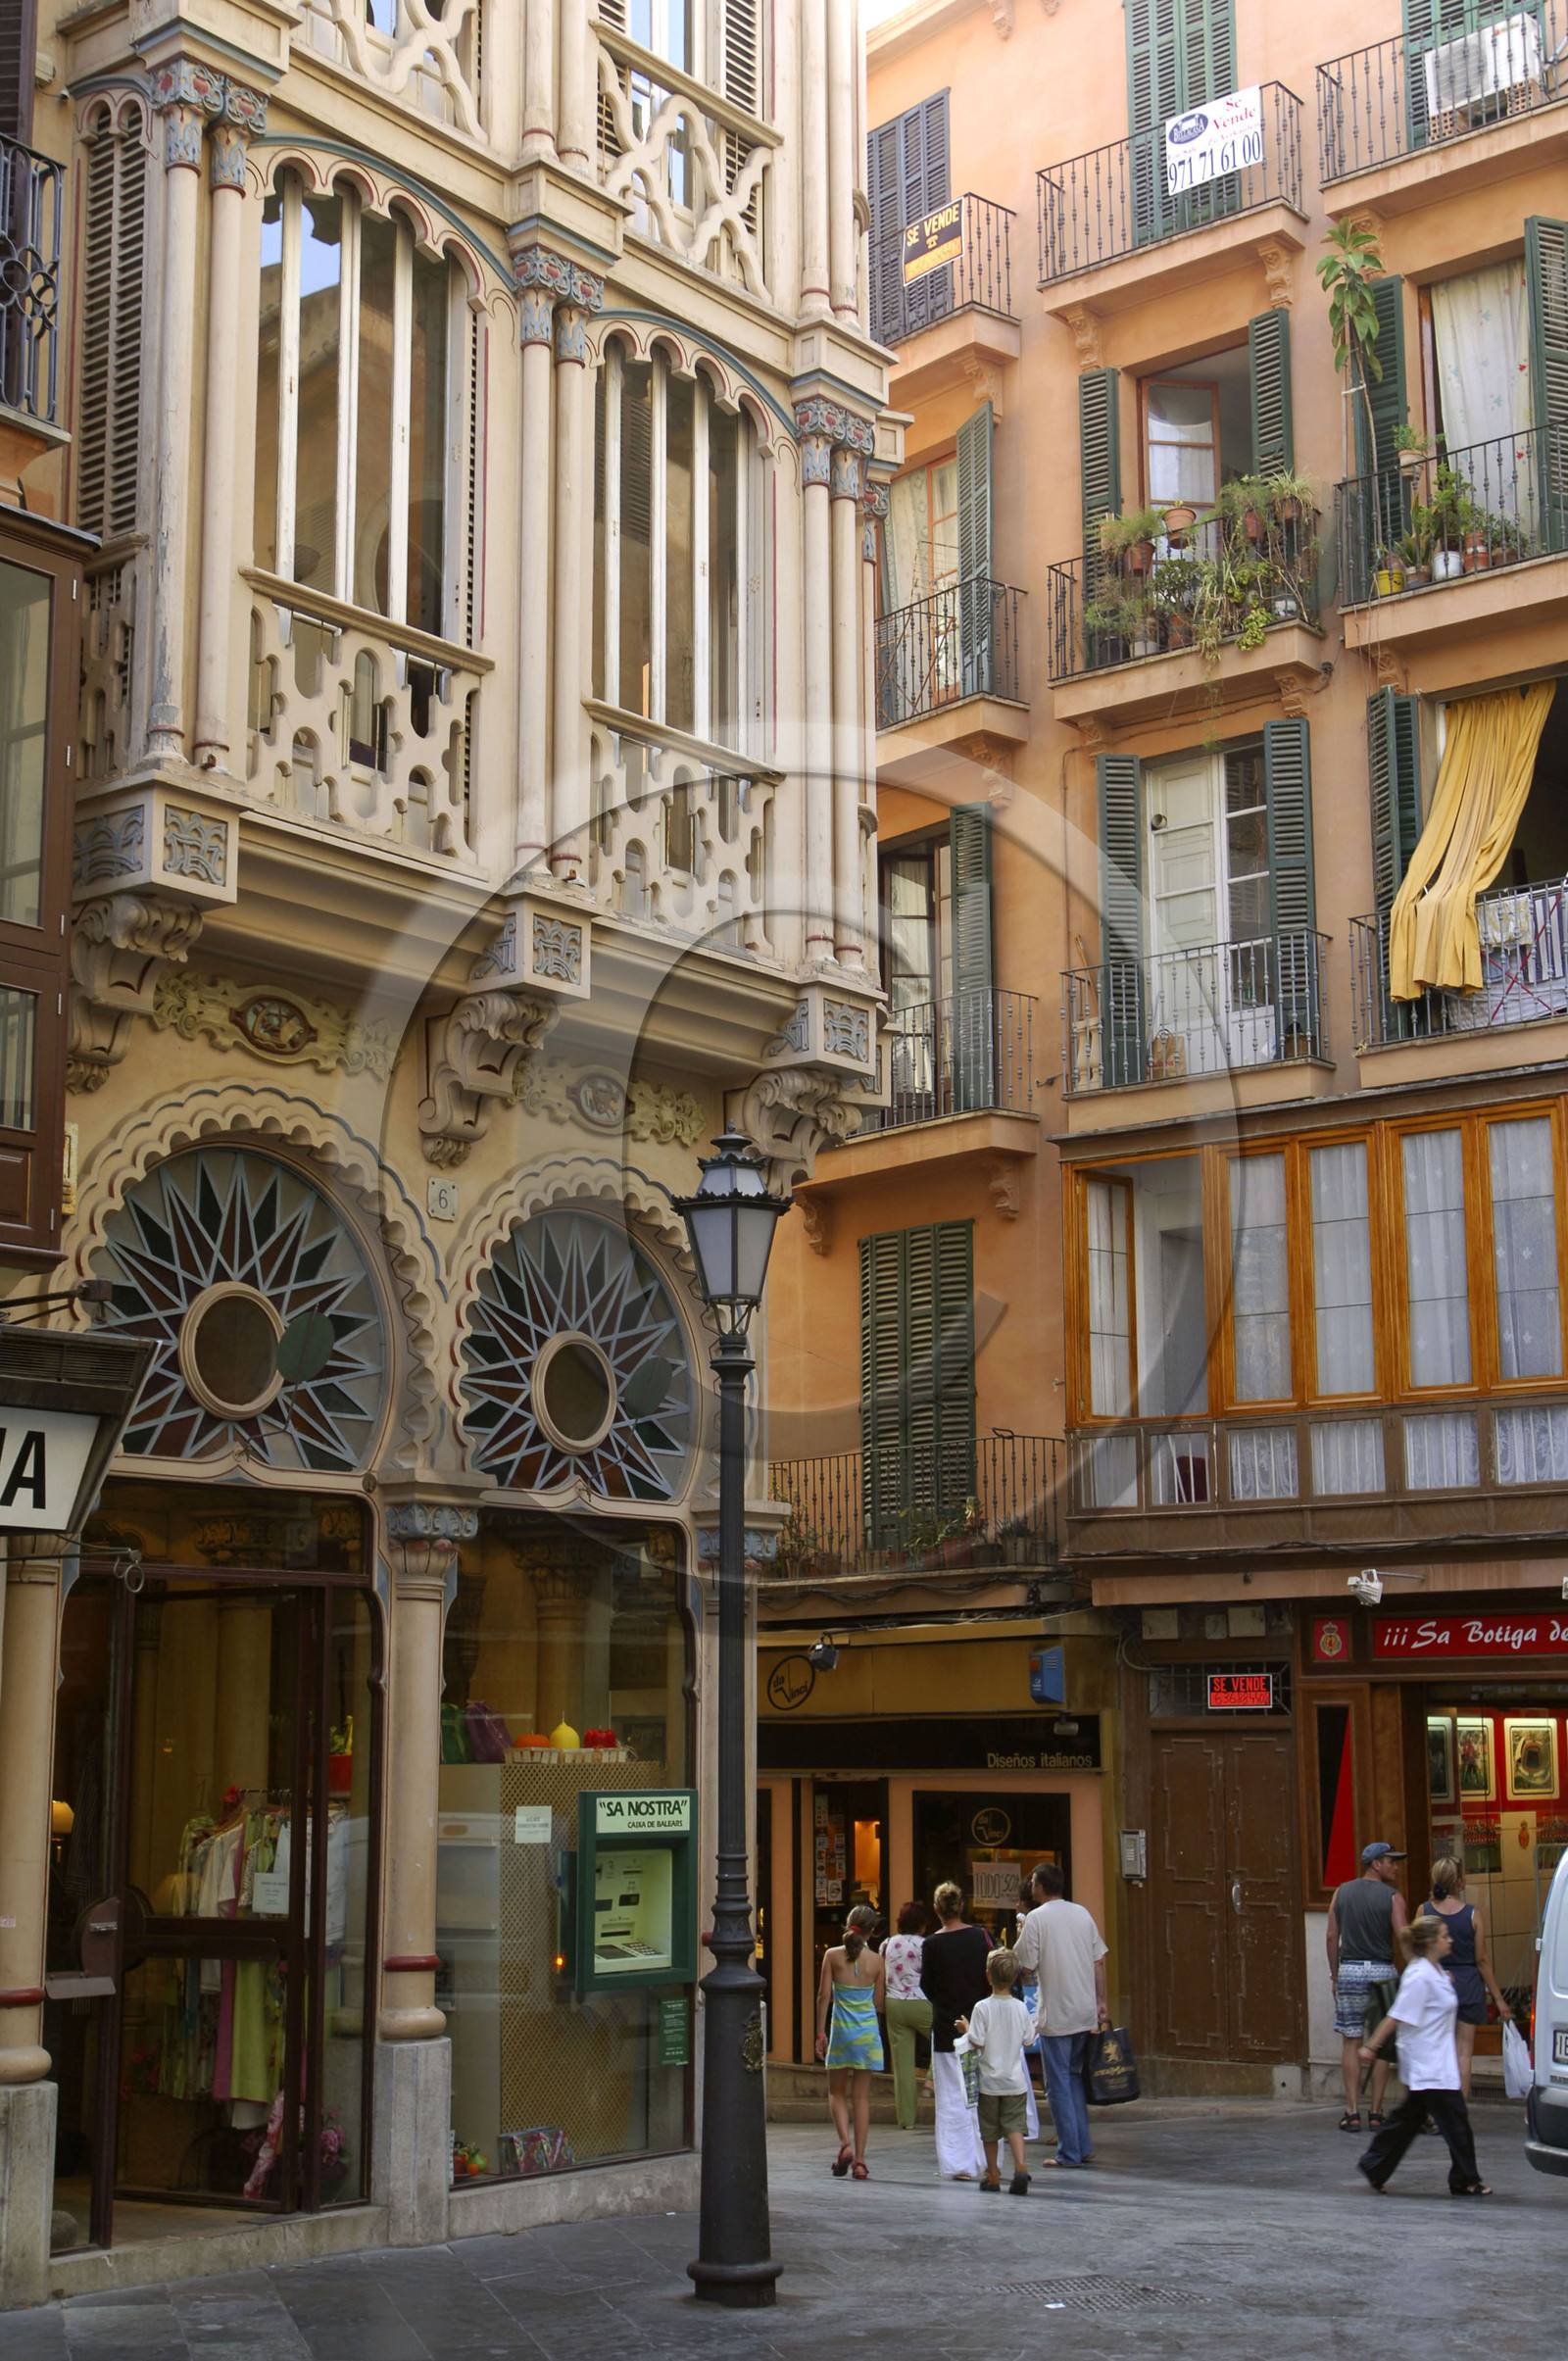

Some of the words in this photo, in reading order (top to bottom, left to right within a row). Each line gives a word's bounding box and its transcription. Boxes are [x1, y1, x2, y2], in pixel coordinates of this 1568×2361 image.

[1225, 98, 1242, 112] Se
[1213, 107, 1256, 129] Vende
[1168, 156, 1194, 193] 971
[1199, 147, 1215, 180] 71
[1220, 139, 1237, 172] 61
[1242, 130, 1261, 165] 00
[906, 224, 919, 247] SE
[923, 203, 959, 237] VENDE
[438, 1188, 448, 1209] 6
[1461, 1620, 1538, 1649] Botiga
[1212, 1677, 1227, 1692] SE
[1231, 1676, 1267, 1692] VENDE
[987, 1751, 1036, 1768] Diseños
[1041, 1750, 1093, 1768] italianos
[657, 1819, 683, 1828] BALEARS
